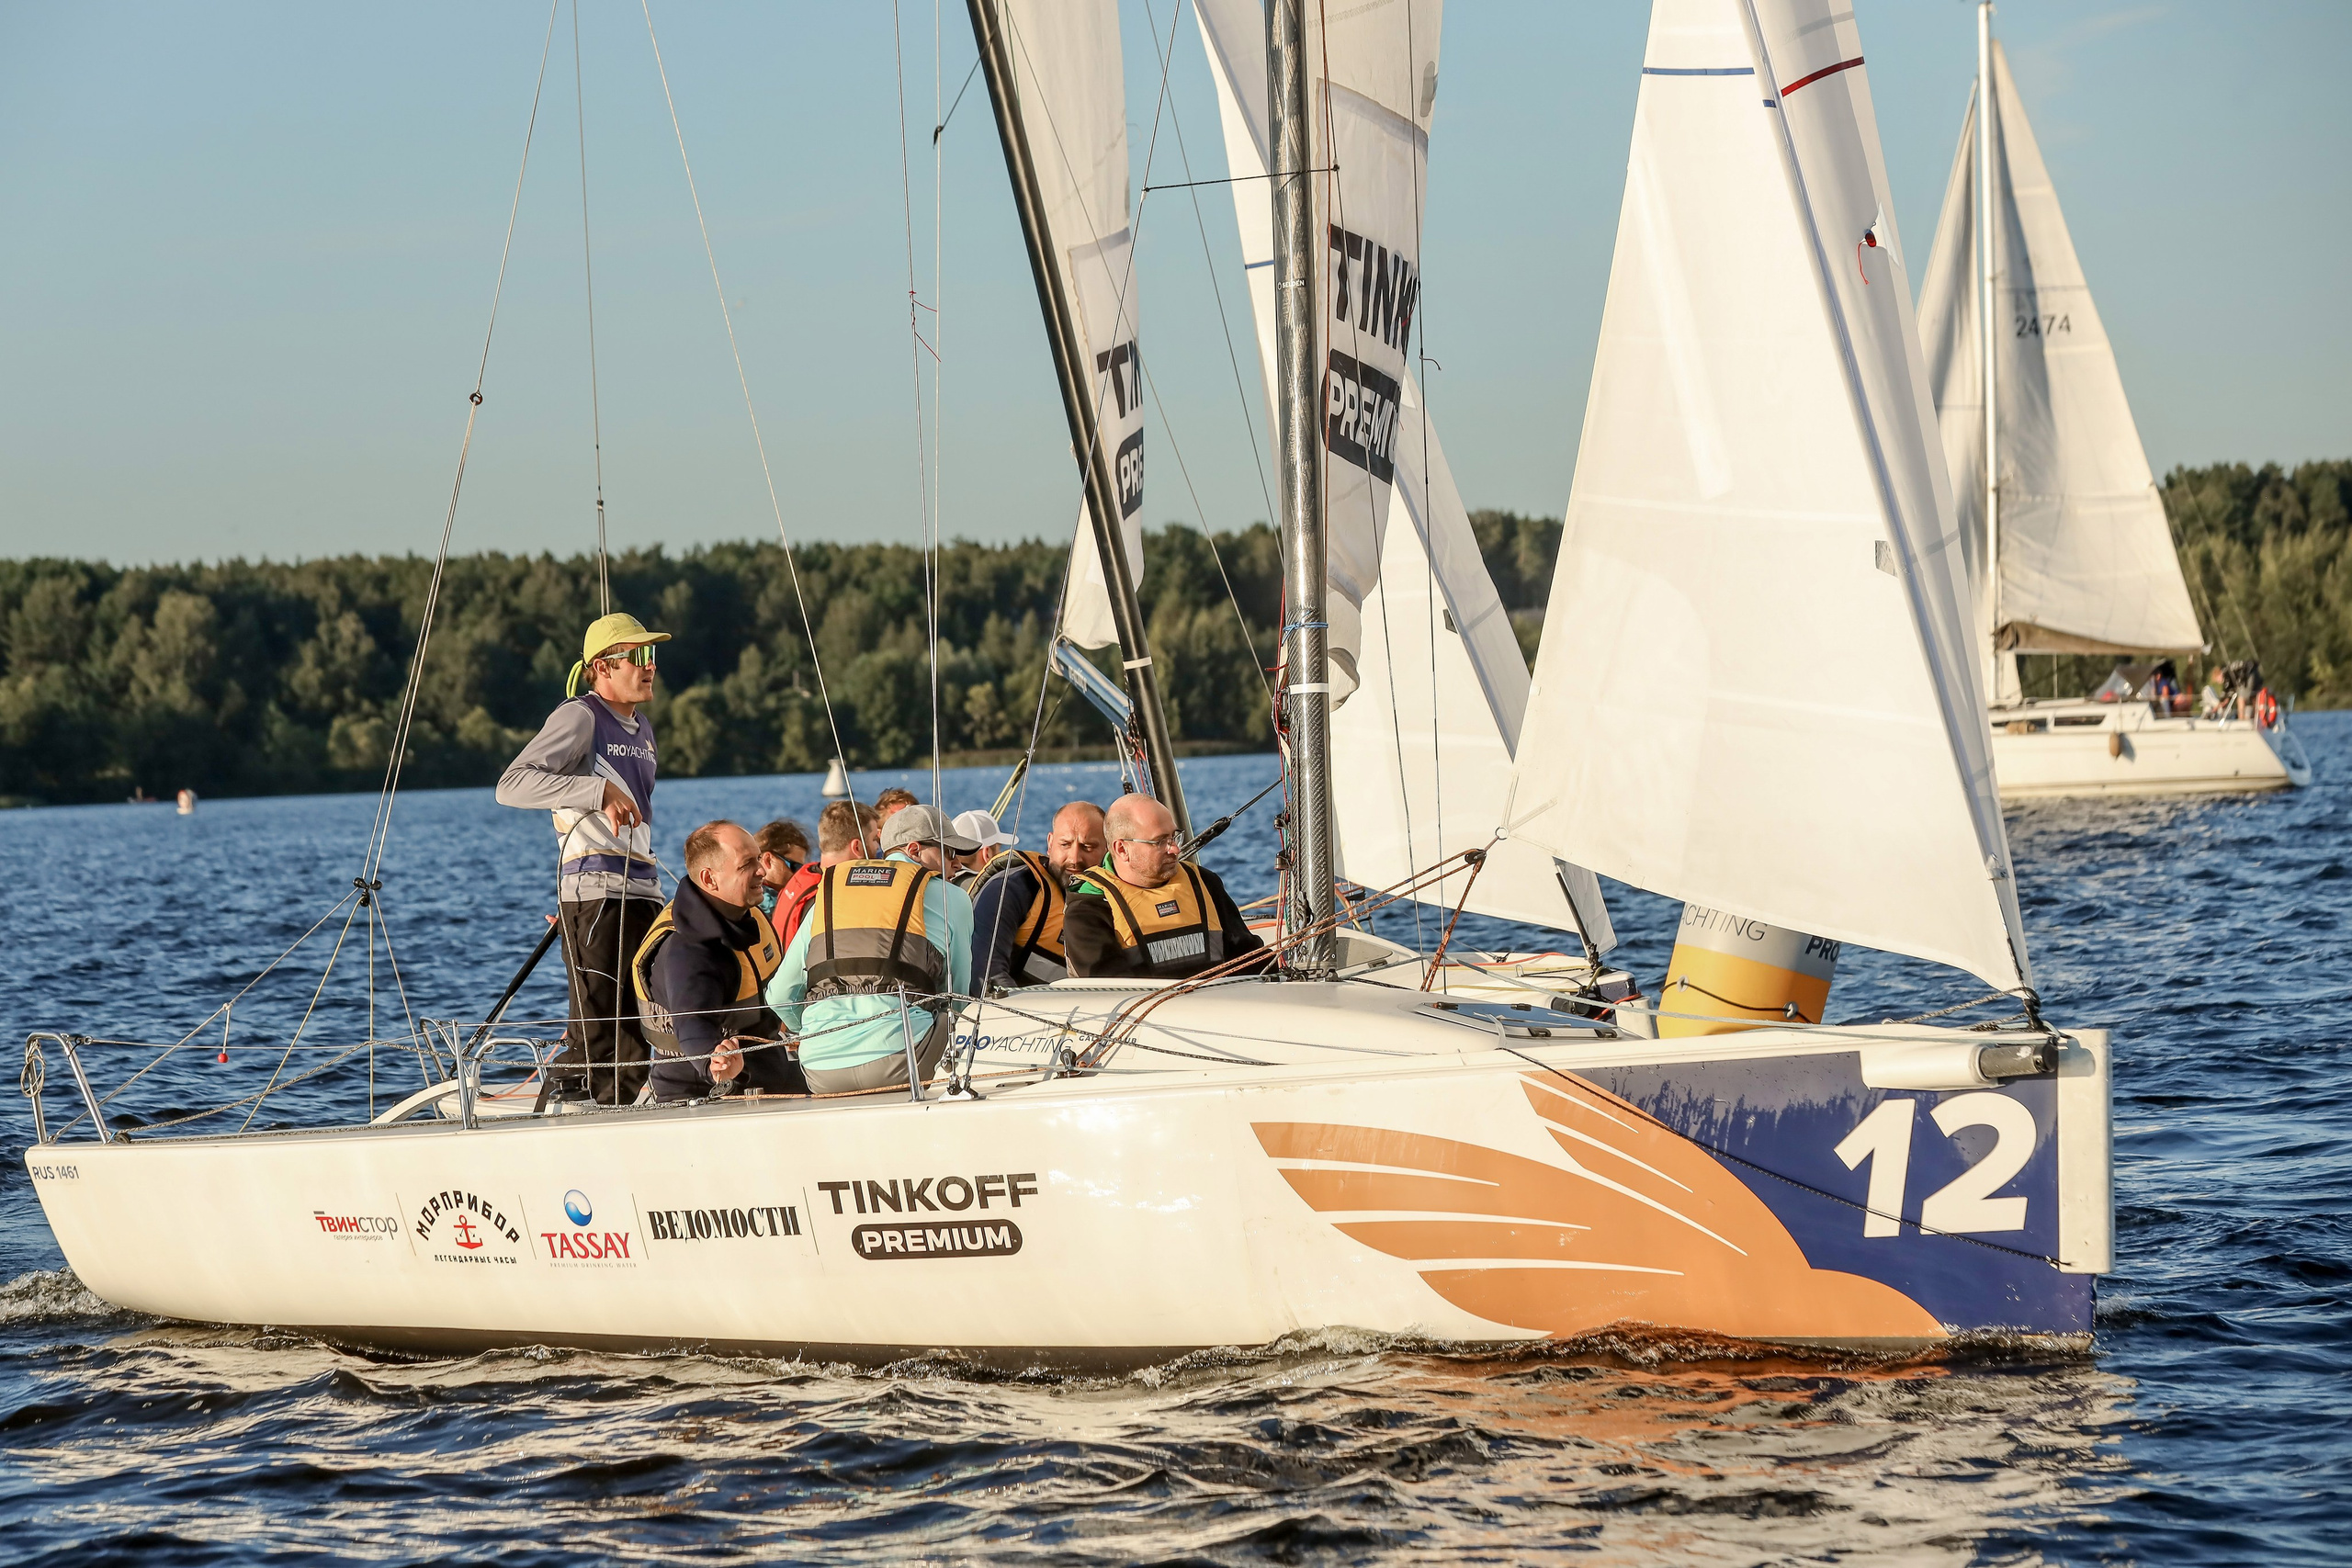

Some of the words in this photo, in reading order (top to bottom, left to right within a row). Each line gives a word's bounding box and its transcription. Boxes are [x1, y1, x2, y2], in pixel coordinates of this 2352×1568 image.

[1327, 223, 1418, 367] TINK
[2015, 313, 2072, 339] 2474
[32, 1166, 55, 1179] RUS
[56, 1165, 80, 1179] 1461
[1833, 1091, 2038, 1238] 12
[818, 1173, 1038, 1214] TINKOFF
[415, 1190, 520, 1244] МОРПРИБОР
[647, 1206, 803, 1244] ВЕДОМОСТИ
[540, 1232, 631, 1259] TASSAY
[861, 1225, 1012, 1255] PREMIUM
[435, 1255, 491, 1264] ЛЕГЕНДАРНЫЕ
